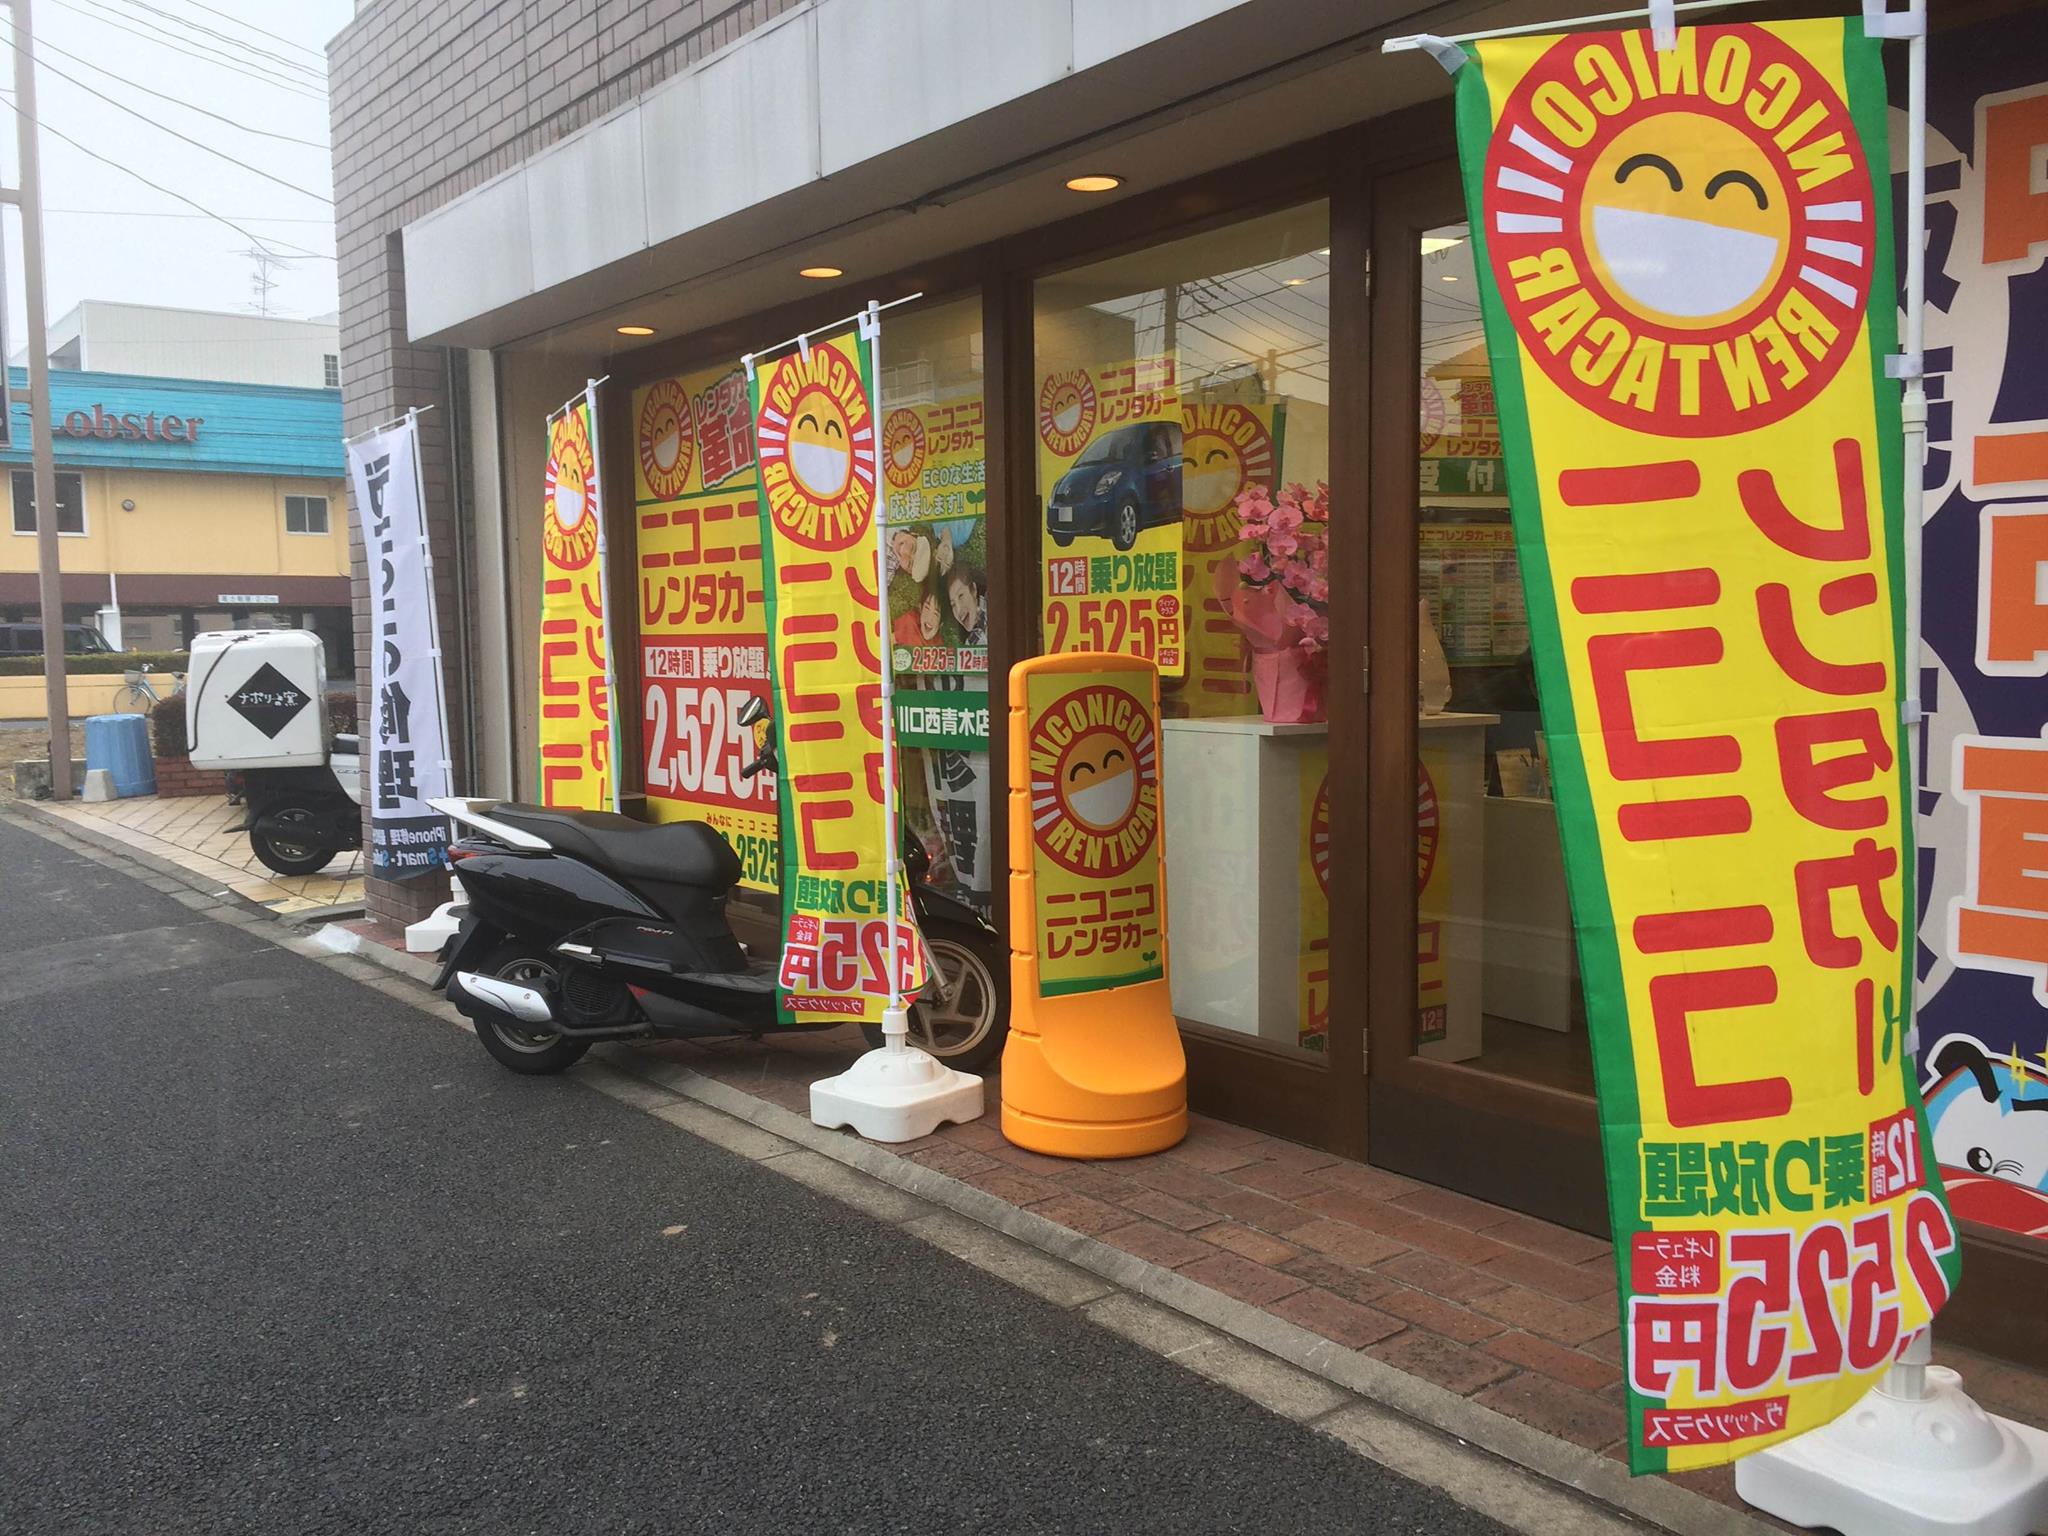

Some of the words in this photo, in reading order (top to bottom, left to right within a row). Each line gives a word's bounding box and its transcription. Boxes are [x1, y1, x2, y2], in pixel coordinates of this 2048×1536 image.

[1100, 358, 1175, 397] ニコニコ
[52, 403, 205, 442] obster
[928, 401, 983, 433] ニコニコ
[1048, 410, 1094, 452] RENTACAR
[928, 430, 985, 455] レンタカー
[1091, 551, 1177, 593] 乗り放題
[650, 649, 694, 676] 12時間
[1030, 693, 1145, 776] NICONICO
[1046, 785, 1158, 869] RENTACAR
[1046, 883, 1156, 927] ニコニコ
[1047, 922, 1158, 960] レンタカー
